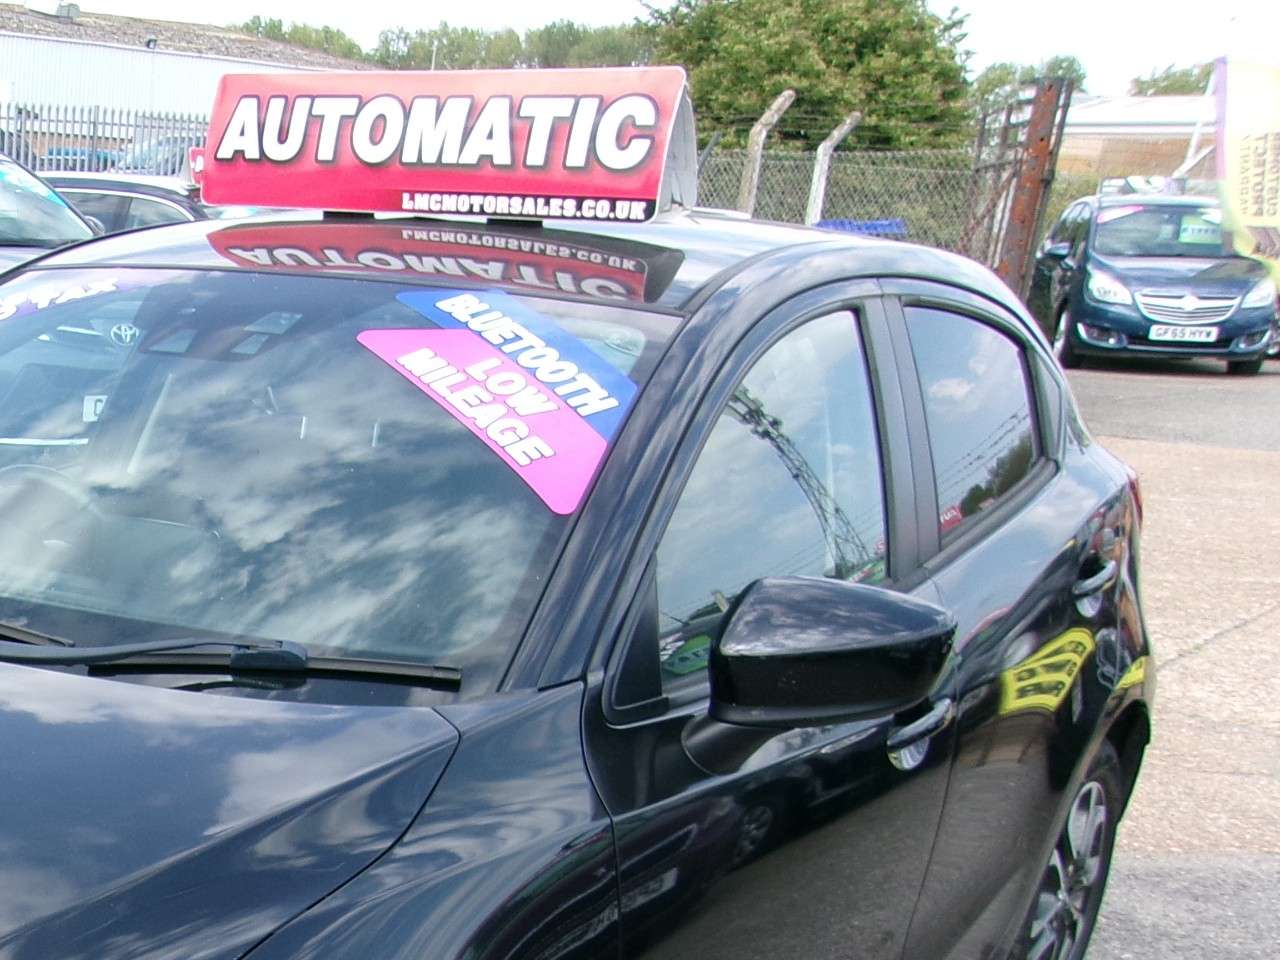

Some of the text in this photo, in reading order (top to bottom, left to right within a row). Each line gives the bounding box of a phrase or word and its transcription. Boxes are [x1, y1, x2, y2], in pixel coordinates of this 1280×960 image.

[216, 95, 658, 169] AUTOMATIC
[401, 192, 646, 221] LMCMOTORSALES.CO.UK
[434, 293, 619, 416] BLUETOOTH
[465, 357, 560, 416] LOW
[395, 347, 556, 467] MILEAGE
